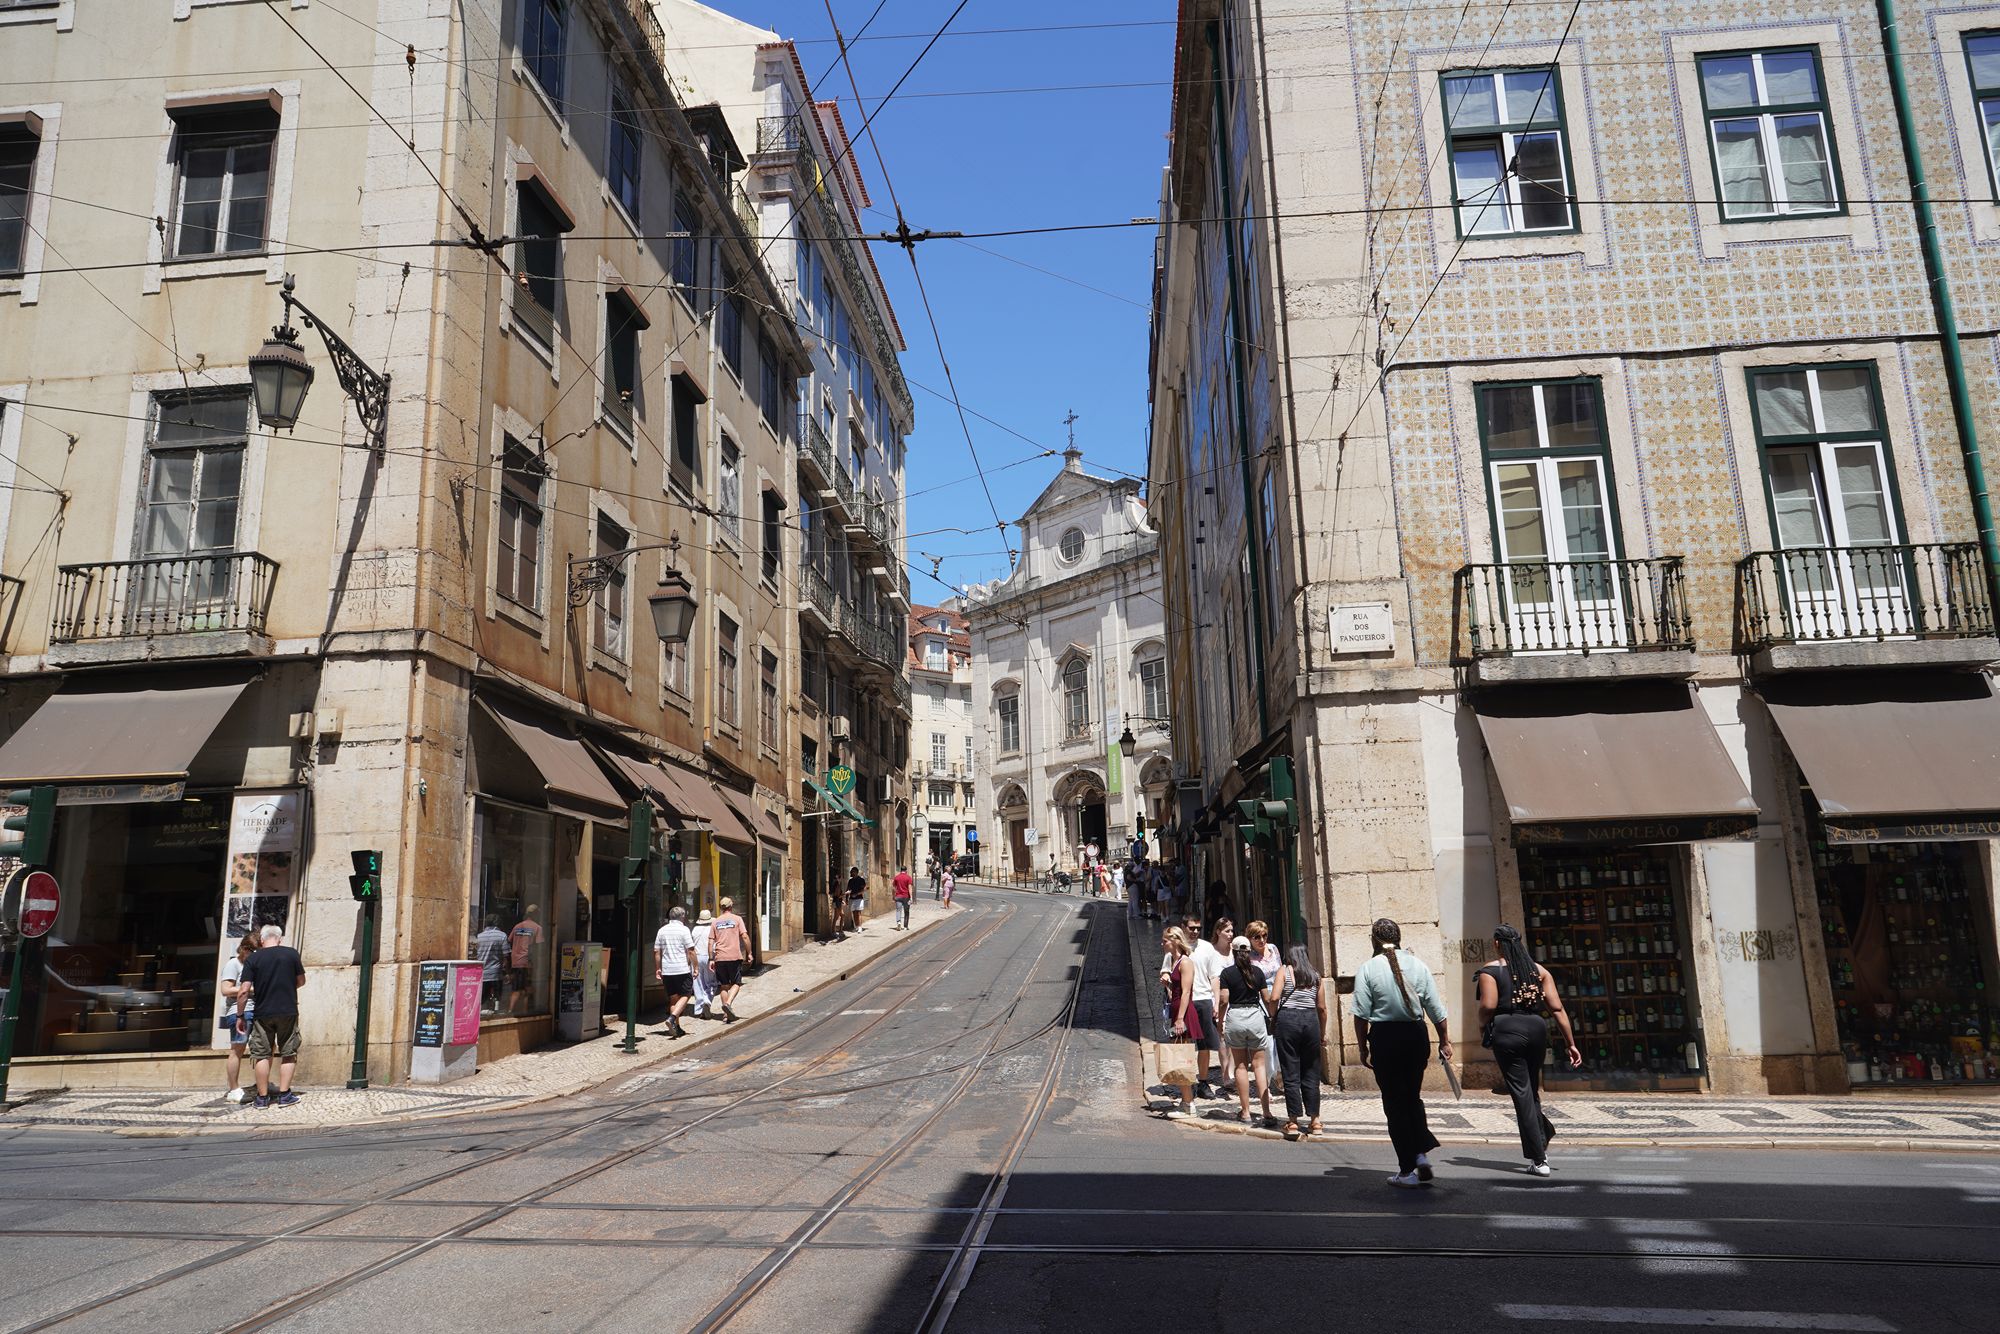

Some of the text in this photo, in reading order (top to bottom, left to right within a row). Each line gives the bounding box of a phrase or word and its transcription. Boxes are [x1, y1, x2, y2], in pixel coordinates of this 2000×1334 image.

[1340, 633, 1386, 642] FANQUEIROS
[243, 816, 288, 827] HERDADE
[255, 826, 279, 834] PSO
[1587, 825, 1680, 841] NAPOLEÃO
[369, 856, 376, 870] 5
